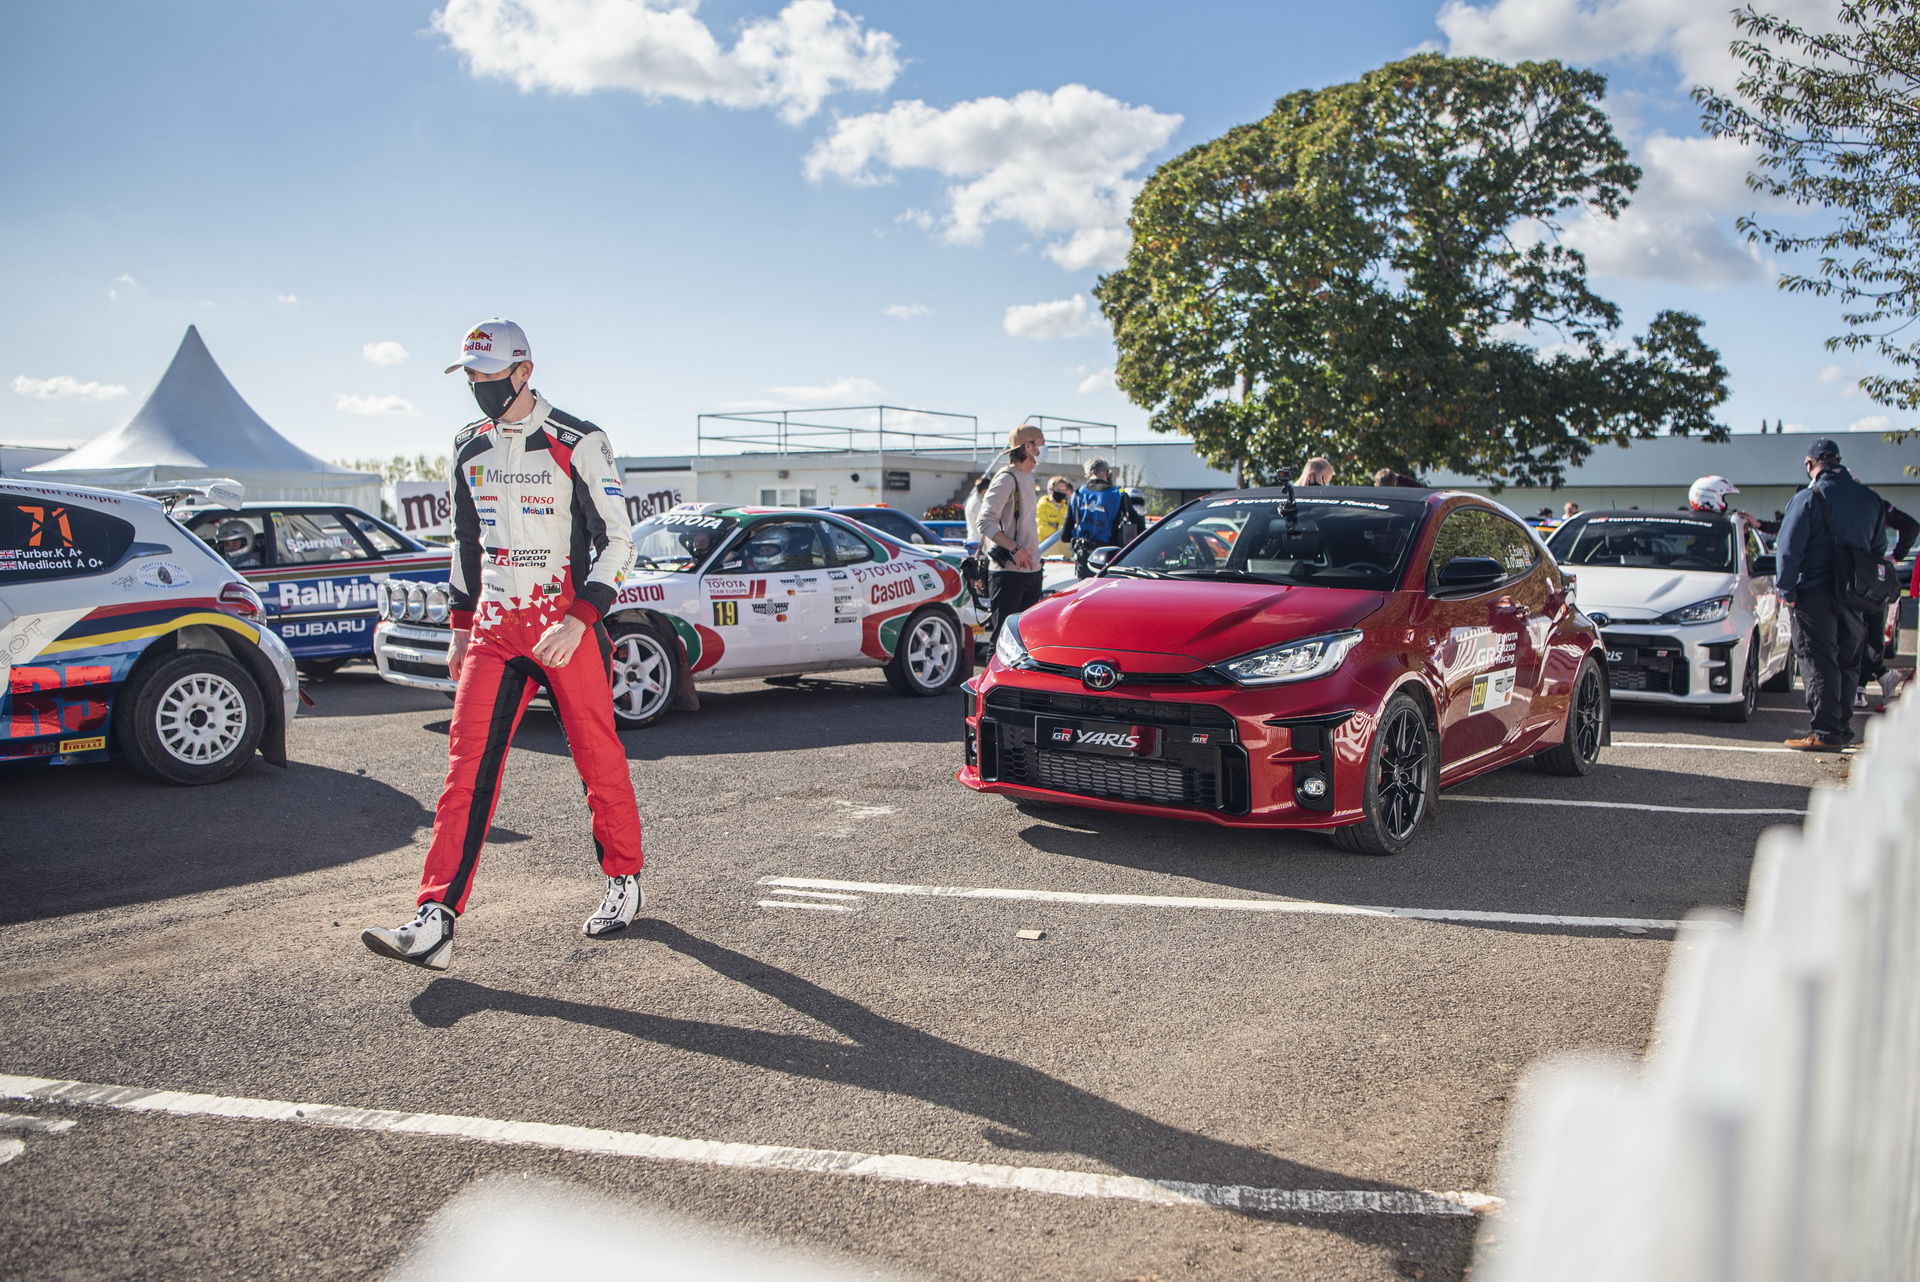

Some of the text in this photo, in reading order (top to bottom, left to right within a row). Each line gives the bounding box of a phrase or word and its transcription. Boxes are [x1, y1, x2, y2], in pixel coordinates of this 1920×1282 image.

[463, 342, 492, 351] Red Bull
[561, 433, 577, 443] OMP
[486, 469, 552, 485] Microsoft
[36, 487, 61, 495] qui
[66, 491, 121, 505] compte
[520, 495, 555, 504] DENSO
[401, 494, 451, 532] m&
[522, 507, 544, 515] Mobil
[17, 505, 73, 548] 71
[655, 515, 723, 530] TOYOTA
[285, 536, 343, 553] Spurrell
[15, 548, 82, 560] Furber.K A+
[18, 558, 103, 570] Medlicott A O+
[865, 561, 917, 578] TOYOTA
[706, 580, 746, 588] TOYOTA
[871, 576, 915, 605] Castrol
[279, 578, 377, 609] Rallyin
[611, 584, 665, 605] astrol
[716, 601, 735, 626] 19
[281, 619, 366, 638] SUBARU
[1606, 651, 1623, 661] RIS
[1471, 681, 1487, 707] ZERO
[63, 739, 103, 751] PIRELLI
[1076, 729, 1140, 748] YARIS
